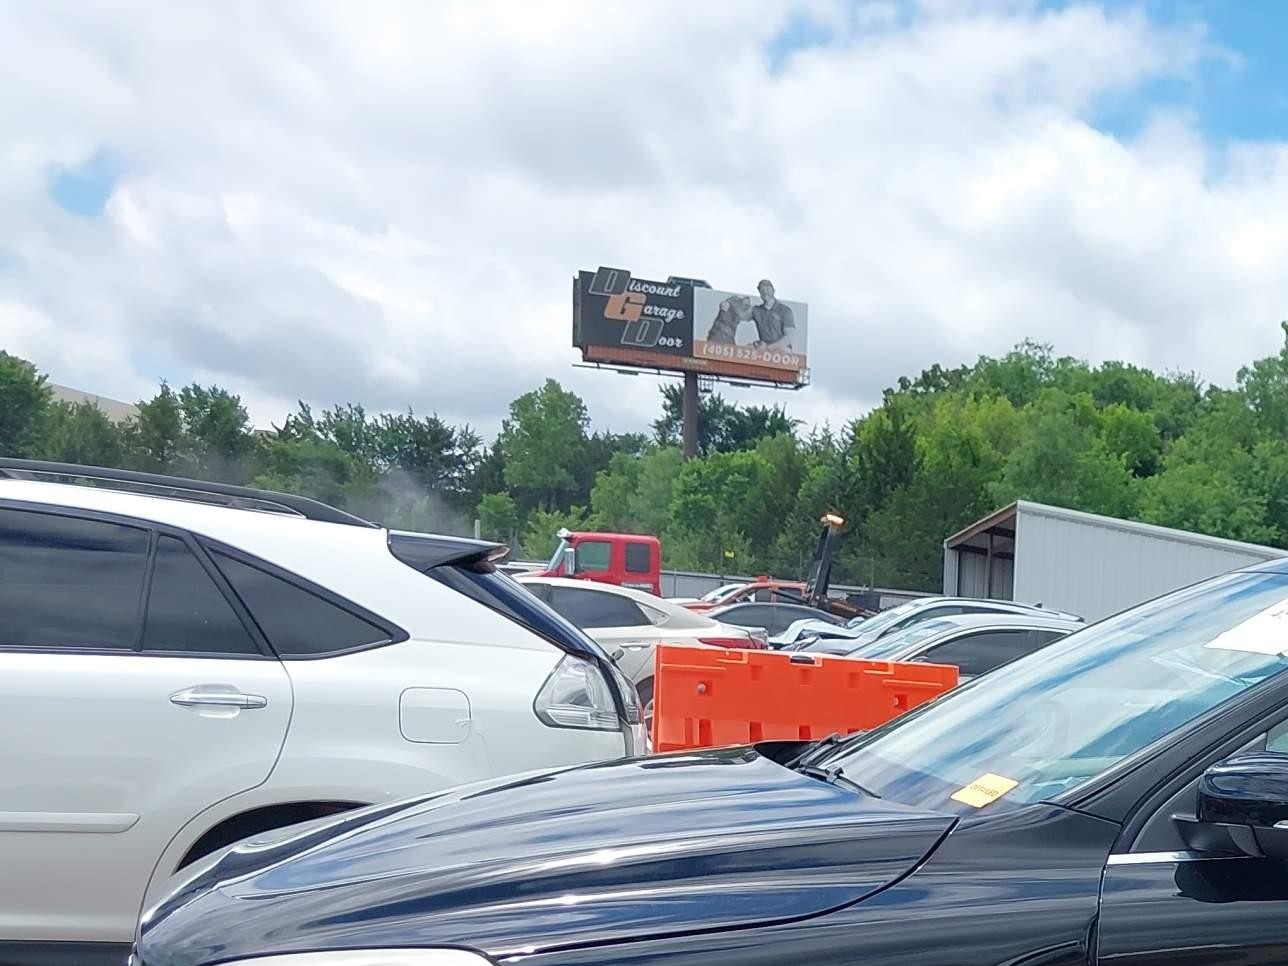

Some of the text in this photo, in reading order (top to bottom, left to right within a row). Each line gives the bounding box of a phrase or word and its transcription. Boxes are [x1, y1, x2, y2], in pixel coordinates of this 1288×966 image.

[588, 267, 681, 297] Discount
[604, 292, 685, 322] Garage
[620, 314, 684, 347] Door
[703, 344, 734, 356] (405)
